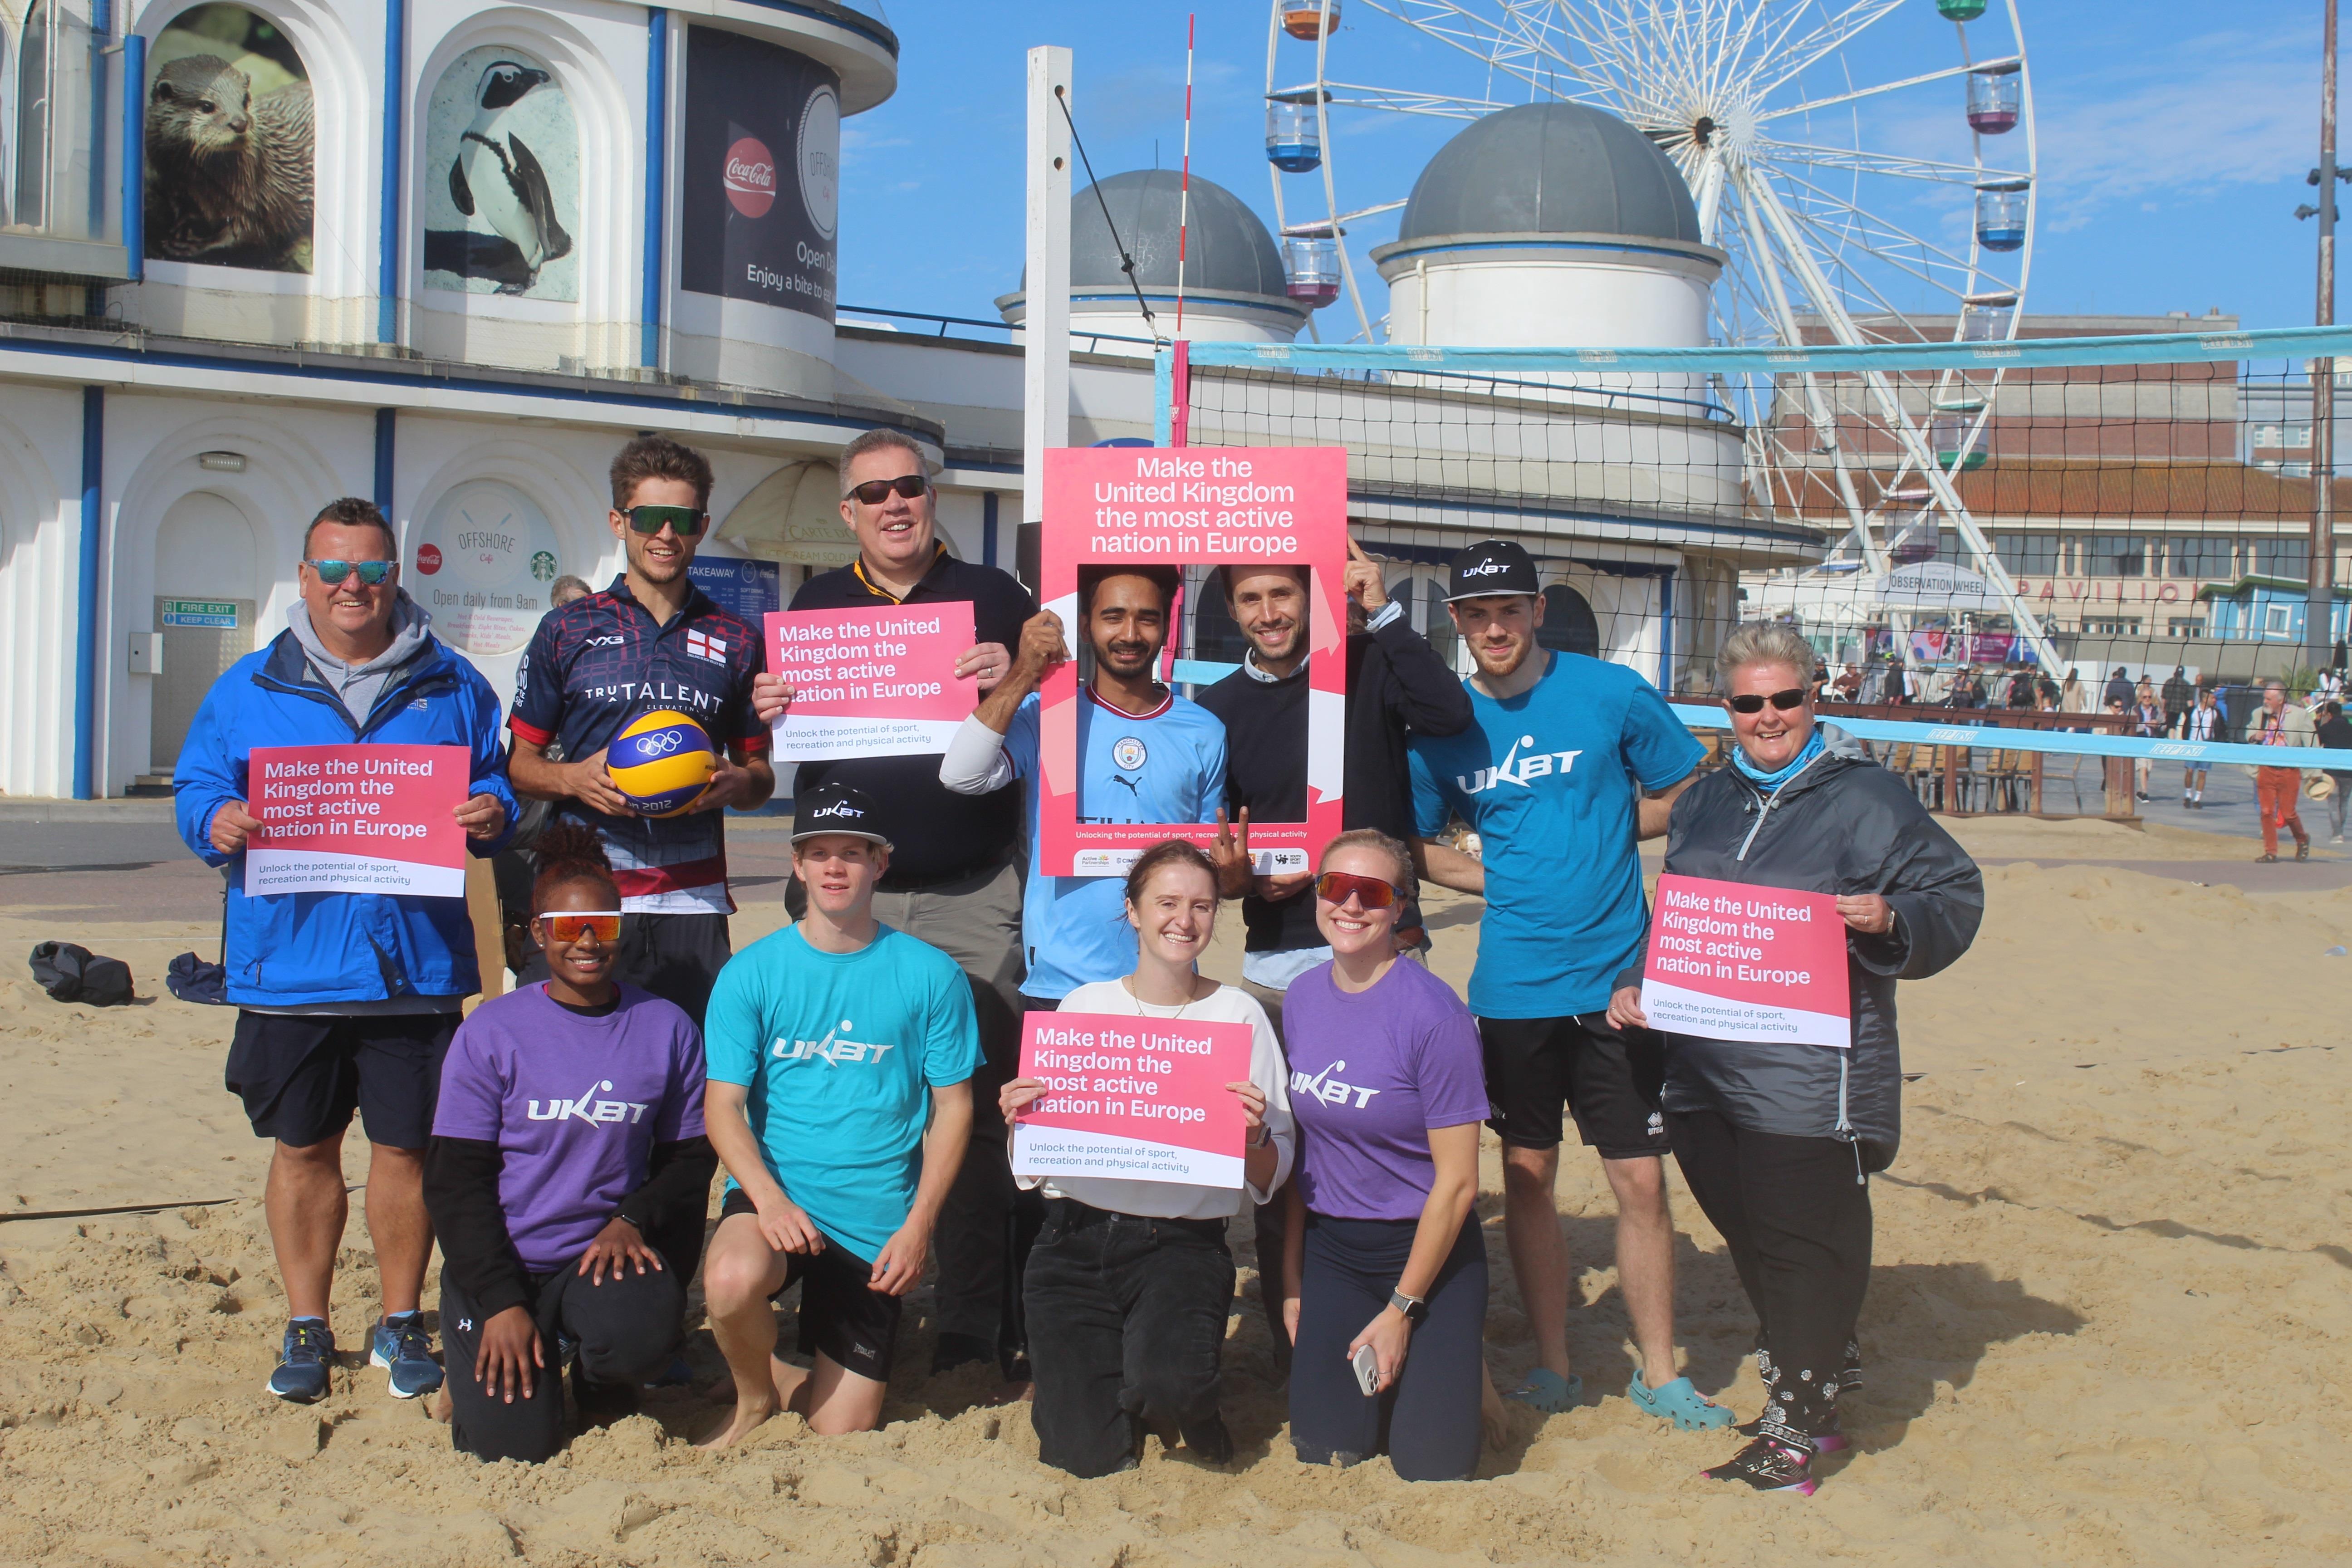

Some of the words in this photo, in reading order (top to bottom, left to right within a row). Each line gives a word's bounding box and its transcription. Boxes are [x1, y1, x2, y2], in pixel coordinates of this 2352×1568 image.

[727, 157, 773, 186] Coca-Cola
[797, 241, 825, 269] Open
[748, 264, 783, 291] Enjoy
[786, 276, 792, 289] a
[795, 274, 812, 295] bite
[814, 282, 822, 298] to
[1137, 457, 1205, 477] Make
[1211, 457, 1252, 477] the
[1095, 482, 1175, 502] United
[1183, 482, 1294, 506] Kingdom
[1096, 507, 1137, 528] the
[1144, 508, 1209, 528] most
[1216, 507, 1293, 528] active
[458, 532, 515, 553] OFFSHORE
[789, 525, 831, 540] CARTE
[1092, 532, 1171, 553] nation
[1178, 532, 1199, 553] in
[1207, 533, 1297, 557] Europe
[784, 550, 820, 560] CREAM
[823, 552, 845, 562] SOLD
[688, 567, 735, 578] TAKEAWAY
[1463, 558, 1511, 577] UKBT
[1891, 575, 1952, 591] OBSERVATION
[1954, 580, 1984, 593] WHEEL
[181, 603, 205, 612] FIRE
[208, 605, 230, 613] EXIT
[434, 589, 458, 608] Open
[463, 592, 486, 610] daily
[491, 593, 512, 608] from
[517, 594, 537, 610] 9am
[779, 624, 833, 642] Make
[838, 622, 871, 638] the
[876, 617, 940, 636] United
[585, 636, 624, 647] VX3
[781, 643, 869, 664] Kingdom
[874, 641, 906, 657] the
[782, 665, 832, 682] most
[837, 662, 896, 680] active
[791, 685, 845, 702] ation
[850, 683, 867, 699] in
[873, 681, 941, 699] Europe
[786, 730, 818, 738] Unlock
[837, 726, 878, 737] potential
[892, 724, 919, 733] sport,
[1926, 729, 1952, 740] DEEP
[1953, 731, 1977, 741] DISH
[787, 740, 834, 749] recreation
[837, 738, 853, 747] and
[856, 736, 894, 747] physical
[897, 735, 931, 744] activity
[1117, 739, 1144, 751] MANCHESTER
[2151, 744, 2178, 755] DEEP
[2179, 746, 2205, 756] DISH
[265, 760, 319, 778] Make
[325, 759, 358, 775] the
[365, 758, 433, 776] United
[1456, 738, 1583, 794] UKBT
[264, 779, 354, 800] Kingdom
[360, 779, 394, 795] the
[263, 801, 314, 818] most
[318, 799, 380, 815] active
[642, 800, 671, 810] 2012
[813, 800, 864, 818] UKBT
[261, 820, 323, 838] nation
[330, 818, 348, 835] in
[354, 819, 427, 839] Europe
[1076, 831, 1112, 839] Unlocking
[1128, 831, 1161, 839] potential
[1250, 831, 1279, 839] physical
[1281, 830, 1307, 838] activity
[259, 863, 292, 873] Unlock
[294, 862, 309, 871] the
[312, 862, 355, 871] potential
[358, 862, 368, 870] of
[370, 863, 399, 873] sport,
[259, 875, 307, 885] recreation
[310, 873, 328, 882] and
[330, 873, 372, 883] physical
[374, 875, 411, 885] activity
[1666, 890, 1710, 911] Make
[1714, 897, 1742, 915] the
[1746, 901, 1811, 922] United
[1662, 911, 1738, 936] Kingdom
[1743, 922, 1774, 941] the
[1659, 935, 1701, 954] most
[1706, 942, 1762, 961] active
[1656, 956, 1711, 976] nation
[1716, 961, 1732, 979] in
[1738, 965, 1811, 986] Europe
[1653, 999, 1683, 1010] Unlock
[1685, 1003, 1699, 1012] the
[1701, 1006, 1741, 1017] potential
[1744, 1009, 1754, 1018] of
[1756, 1011, 1785, 1020] sport,
[1653, 1011, 1698, 1024] recreation
[1700, 1018, 1716, 1026] and
[1718, 1020, 1758, 1030] physical
[1761, 1023, 1798, 1033] activity
[773, 1022, 894, 1068] UKBT
[1036, 1028, 1094, 1047] Make
[1100, 1029, 1135, 1049] the
[1142, 1033, 1212, 1055] United
[1034, 1050, 1131, 1072] Kingdom
[1137, 1055, 1172, 1074] the
[1093, 1076, 1158, 1095] active
[528, 1080, 649, 1129] UKBT
[1032, 1096, 1099, 1114] nation
[1106, 1097, 1124, 1115] in
[1131, 1099, 1205, 1124] Europe
[1030, 1143, 1065, 1153] Unlock
[1068, 1144, 1084, 1153] the
[1087, 1145, 1132, 1156] potential
[1135, 1147, 1145, 1156] of
[1148, 1149, 1177, 1160] sport,
[1029, 1156, 1082, 1166] recreation
[1084, 1157, 1104, 1166] and
[1106, 1159, 1149, 1169] physical
[1152, 1162, 1189, 1173] activity
